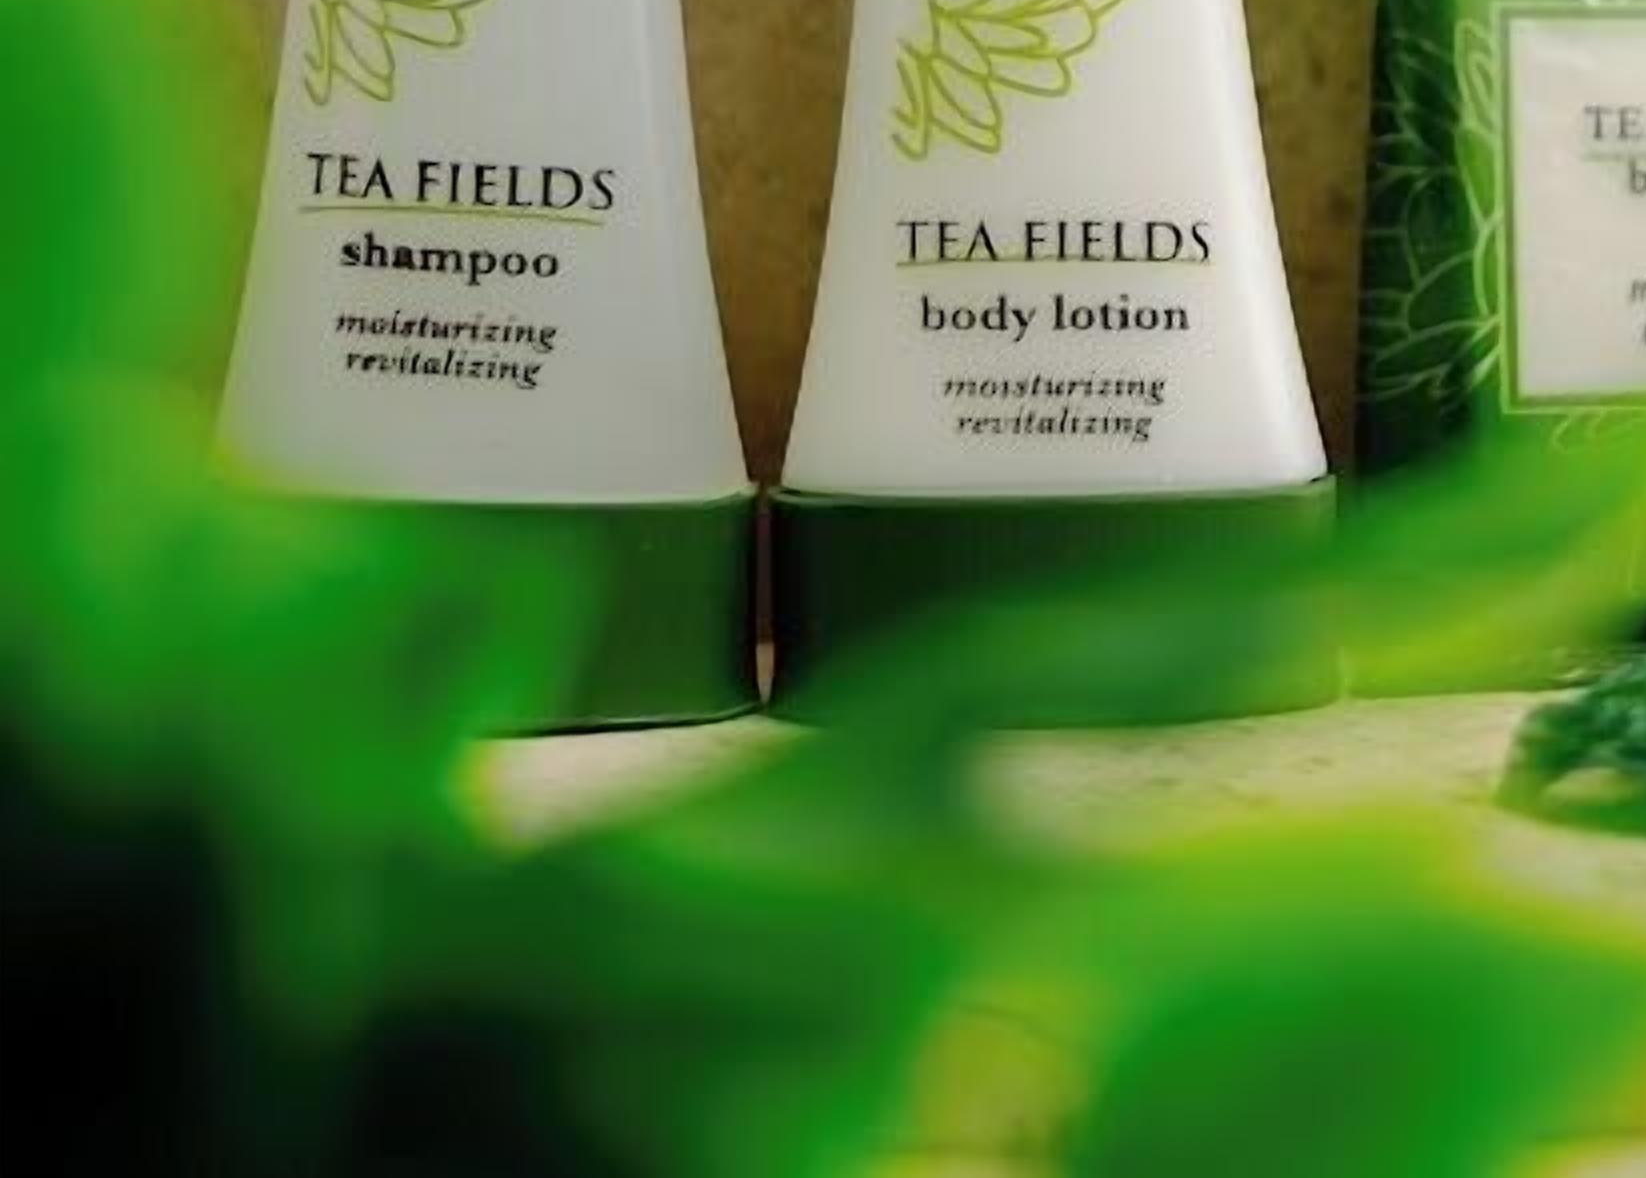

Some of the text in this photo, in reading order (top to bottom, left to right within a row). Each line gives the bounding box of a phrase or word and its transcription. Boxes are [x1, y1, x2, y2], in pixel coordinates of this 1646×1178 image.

[307, 152, 616, 210] TEA FIELDS
[340, 231, 559, 285] shampoo
[897, 220, 1211, 264] TEA FIELDS
[335, 310, 558, 352] moisturizing
[920, 294, 1190, 342] body lotion
[345, 350, 542, 389] revitalizing
[943, 373, 1166, 405] moisturizing
[957, 409, 1153, 442] revitalizing
